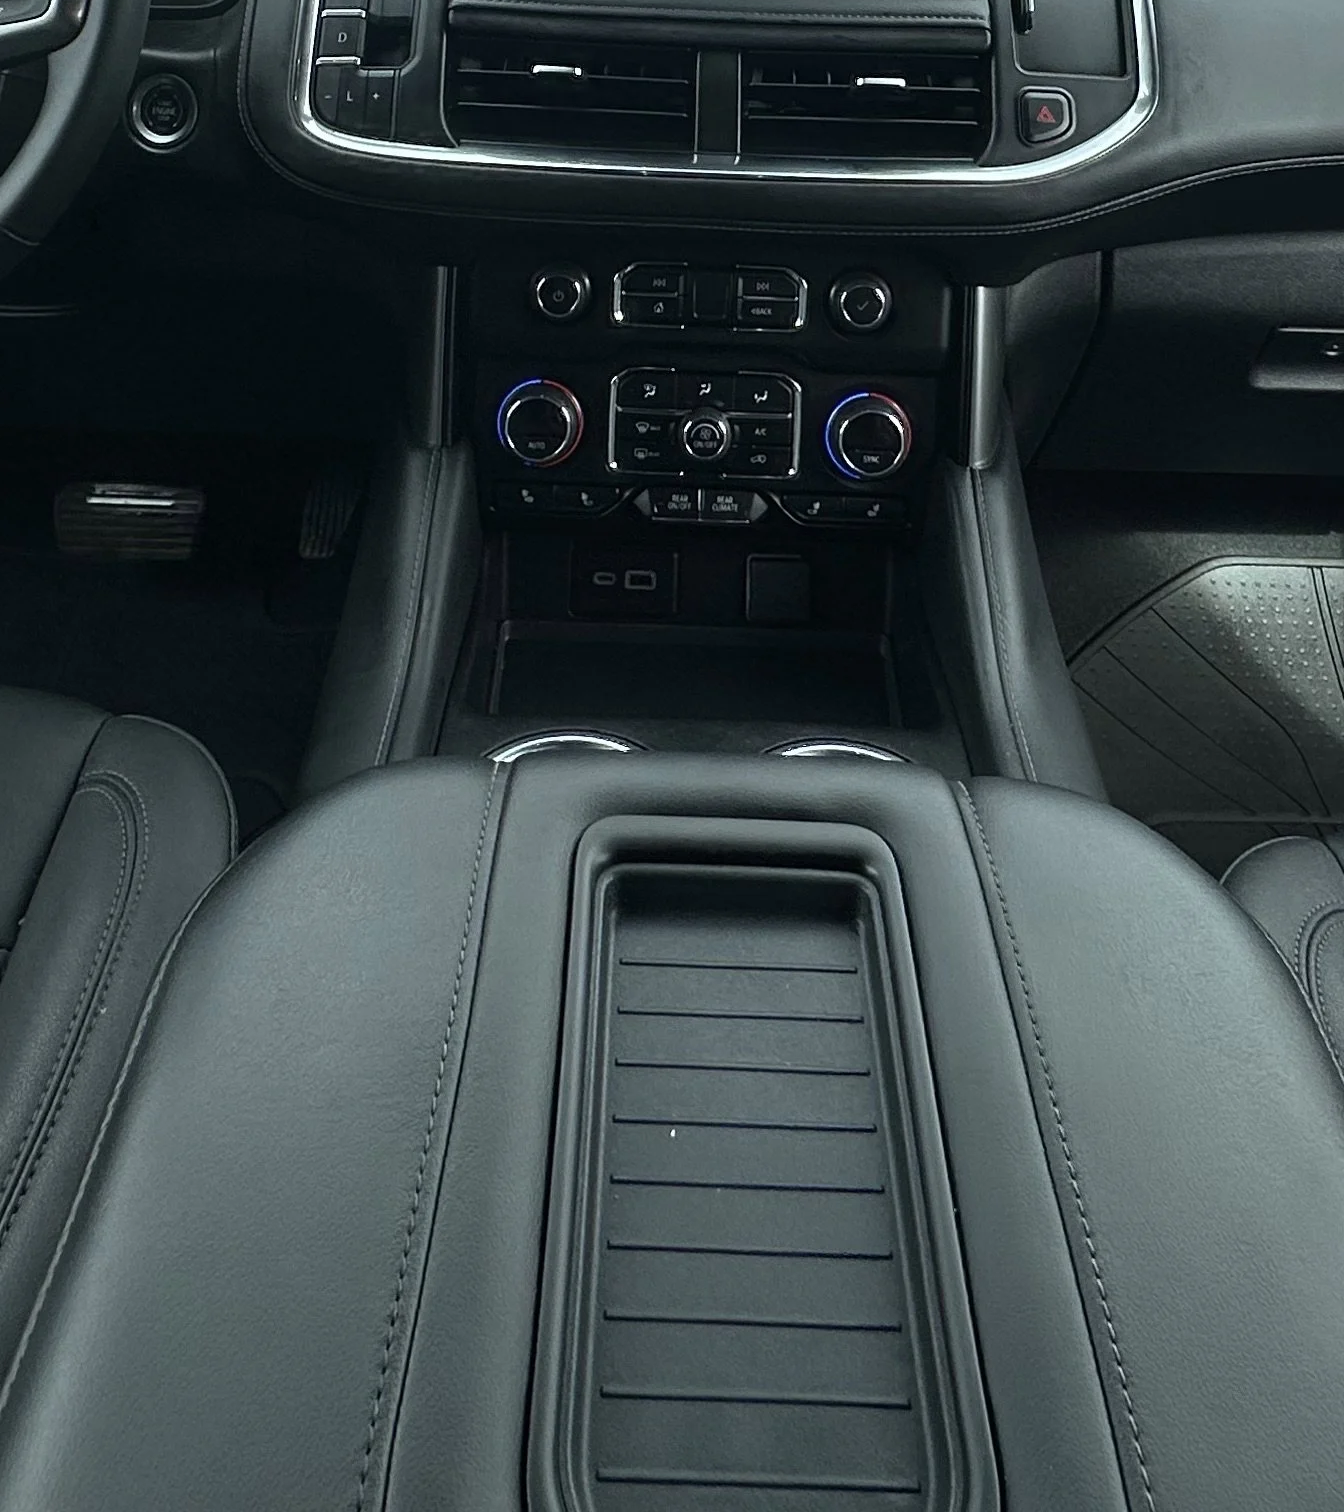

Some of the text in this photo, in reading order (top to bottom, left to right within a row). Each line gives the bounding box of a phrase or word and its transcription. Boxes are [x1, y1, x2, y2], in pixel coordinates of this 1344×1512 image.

[337, 32, 348, 43] D
[345, 91, 354, 102] L
[756, 307, 773, 316] BACK
[754, 427, 768, 437] A/C
[863, 455, 880, 465] SYNC
